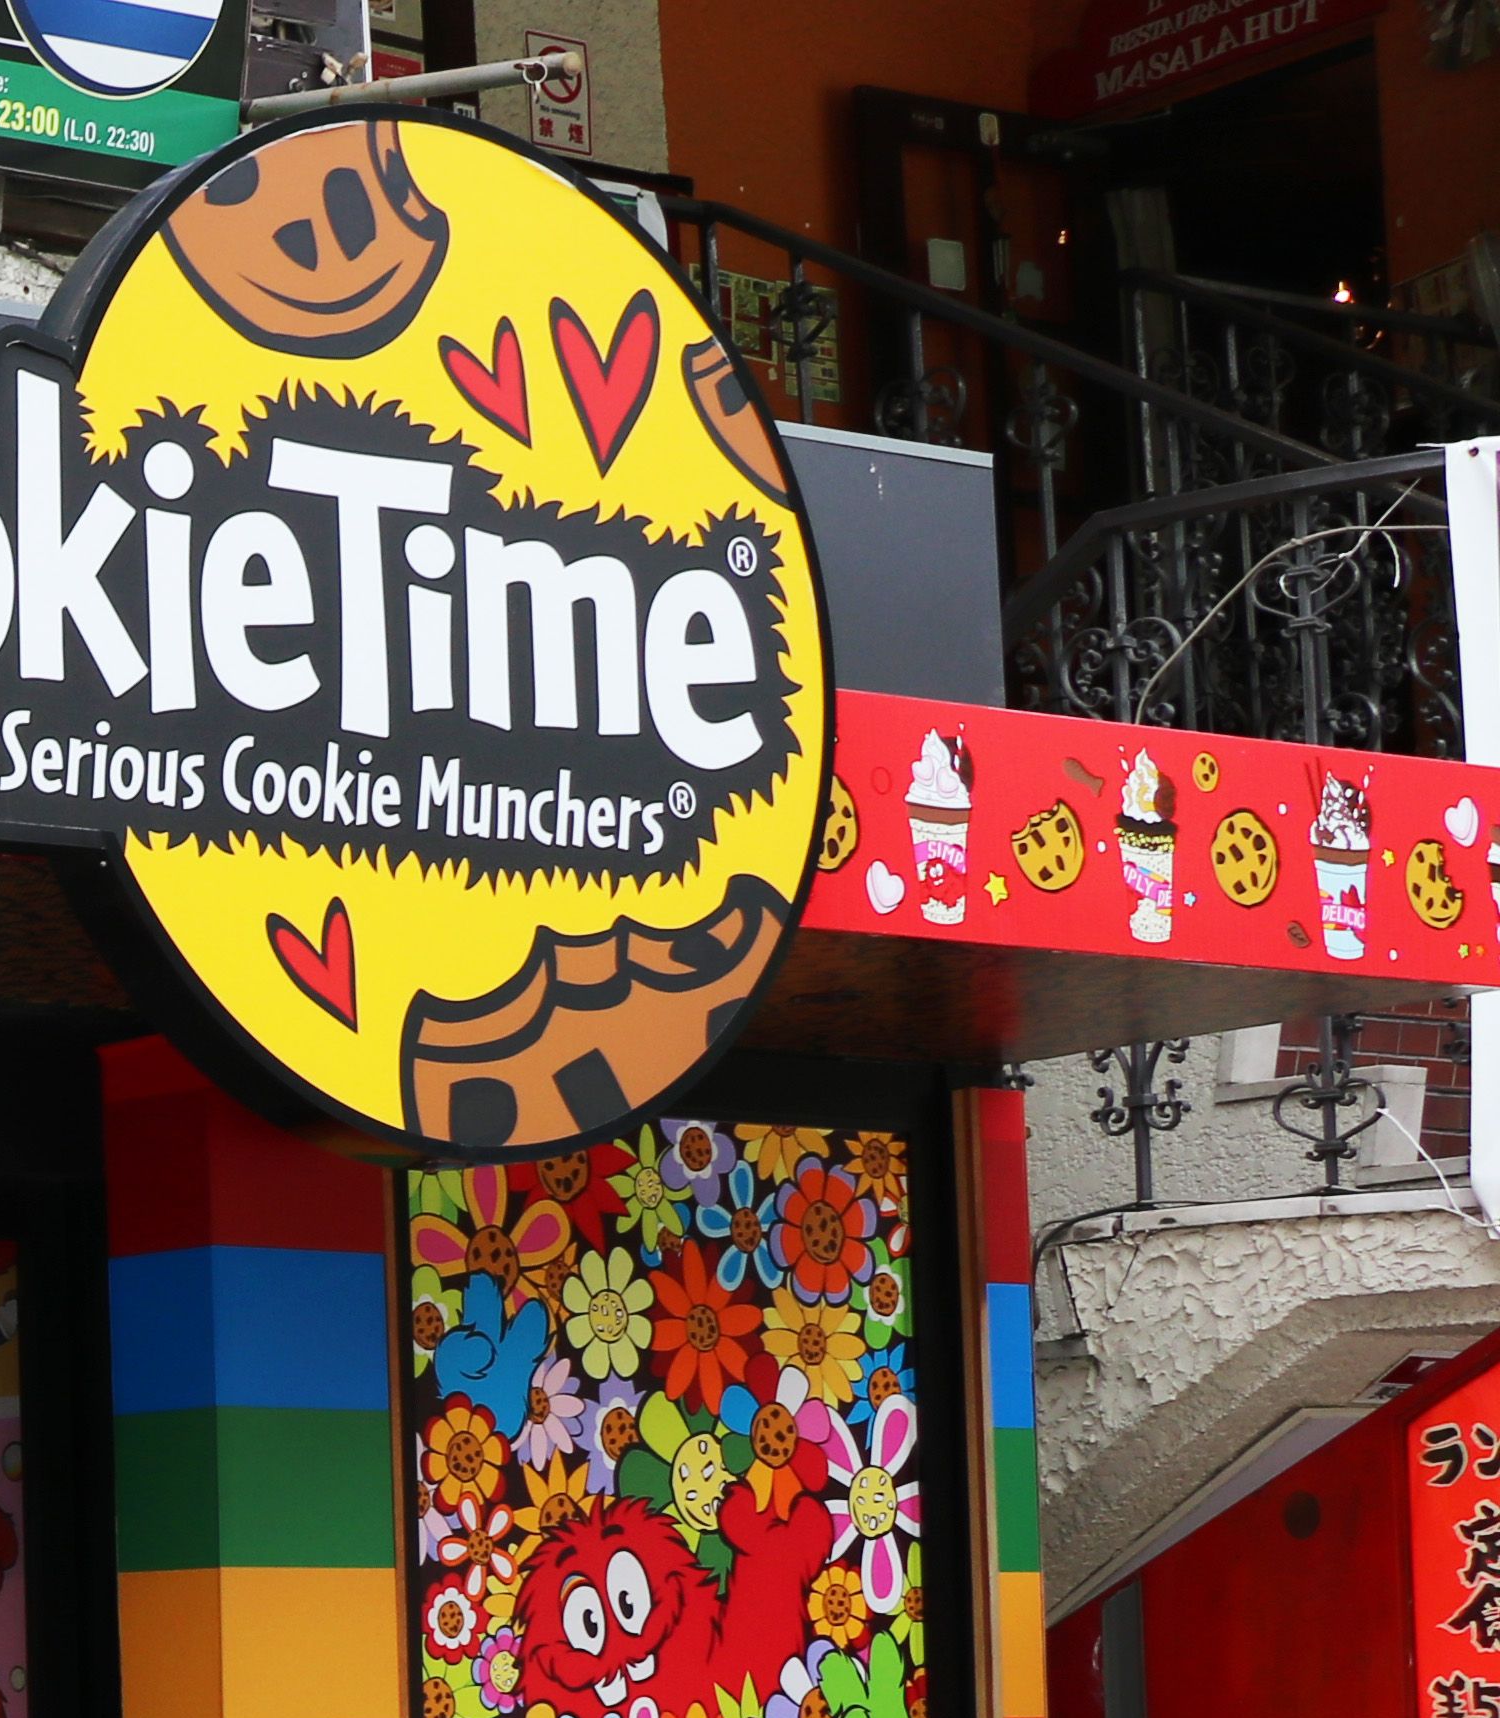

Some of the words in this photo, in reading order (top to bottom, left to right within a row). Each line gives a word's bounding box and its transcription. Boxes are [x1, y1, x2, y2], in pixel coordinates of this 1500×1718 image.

[63, 117, 101, 145] (L.O.
[106, 124, 156, 156] 22:30)
[0, 710, 204, 812] Serious
[221, 736, 402, 832] Cookie
